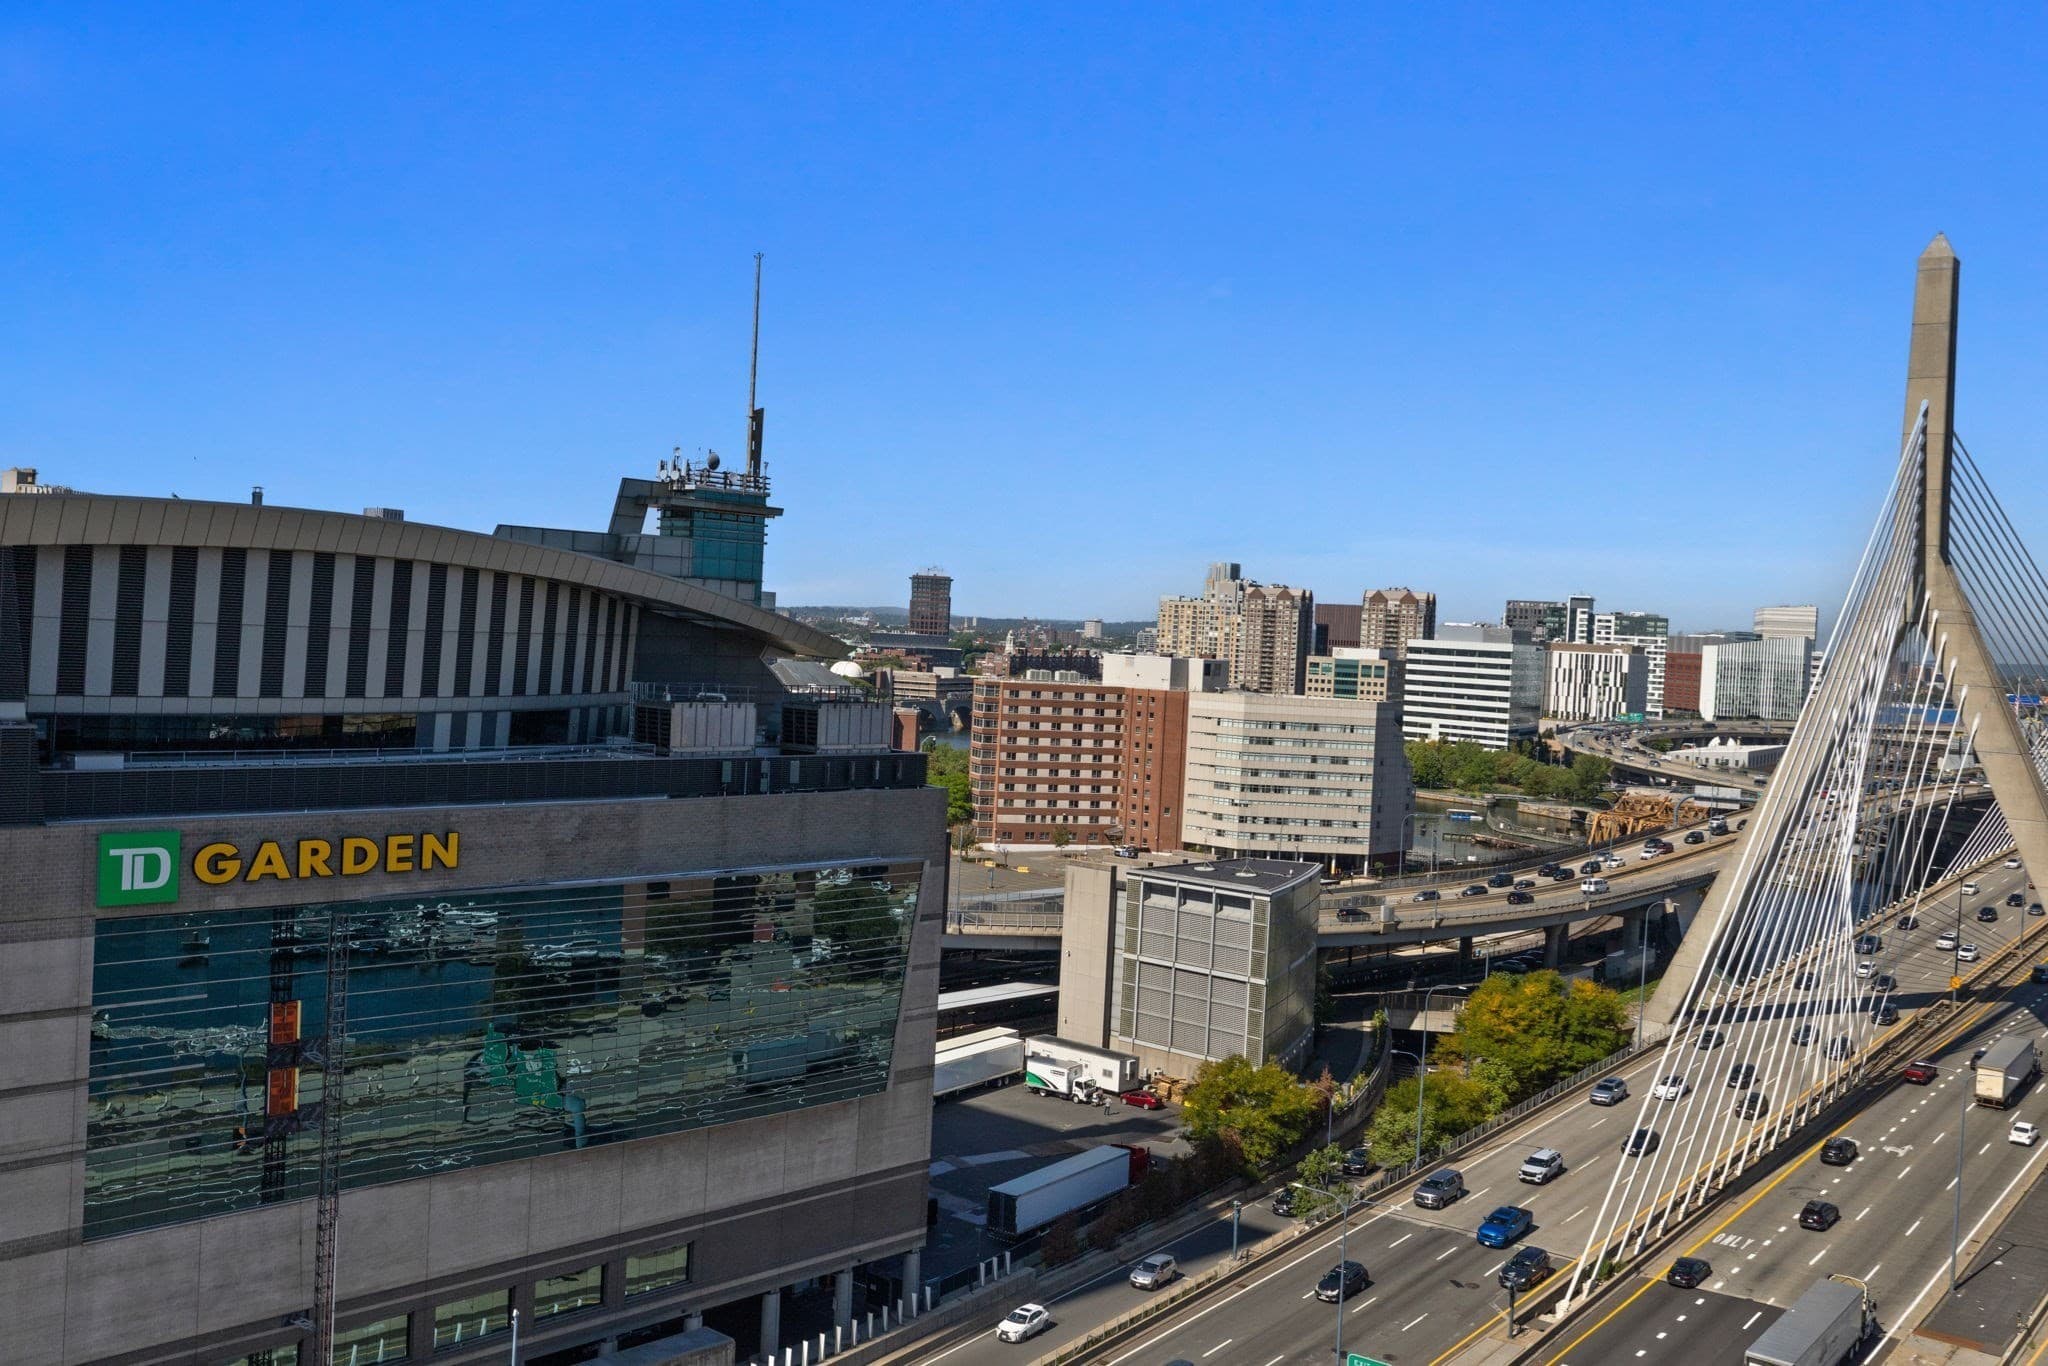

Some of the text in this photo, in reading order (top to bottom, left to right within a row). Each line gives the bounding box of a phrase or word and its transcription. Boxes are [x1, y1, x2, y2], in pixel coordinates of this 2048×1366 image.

[109, 832, 459, 891] TD GARDEN
[1711, 1232, 1756, 1250] ONLY
